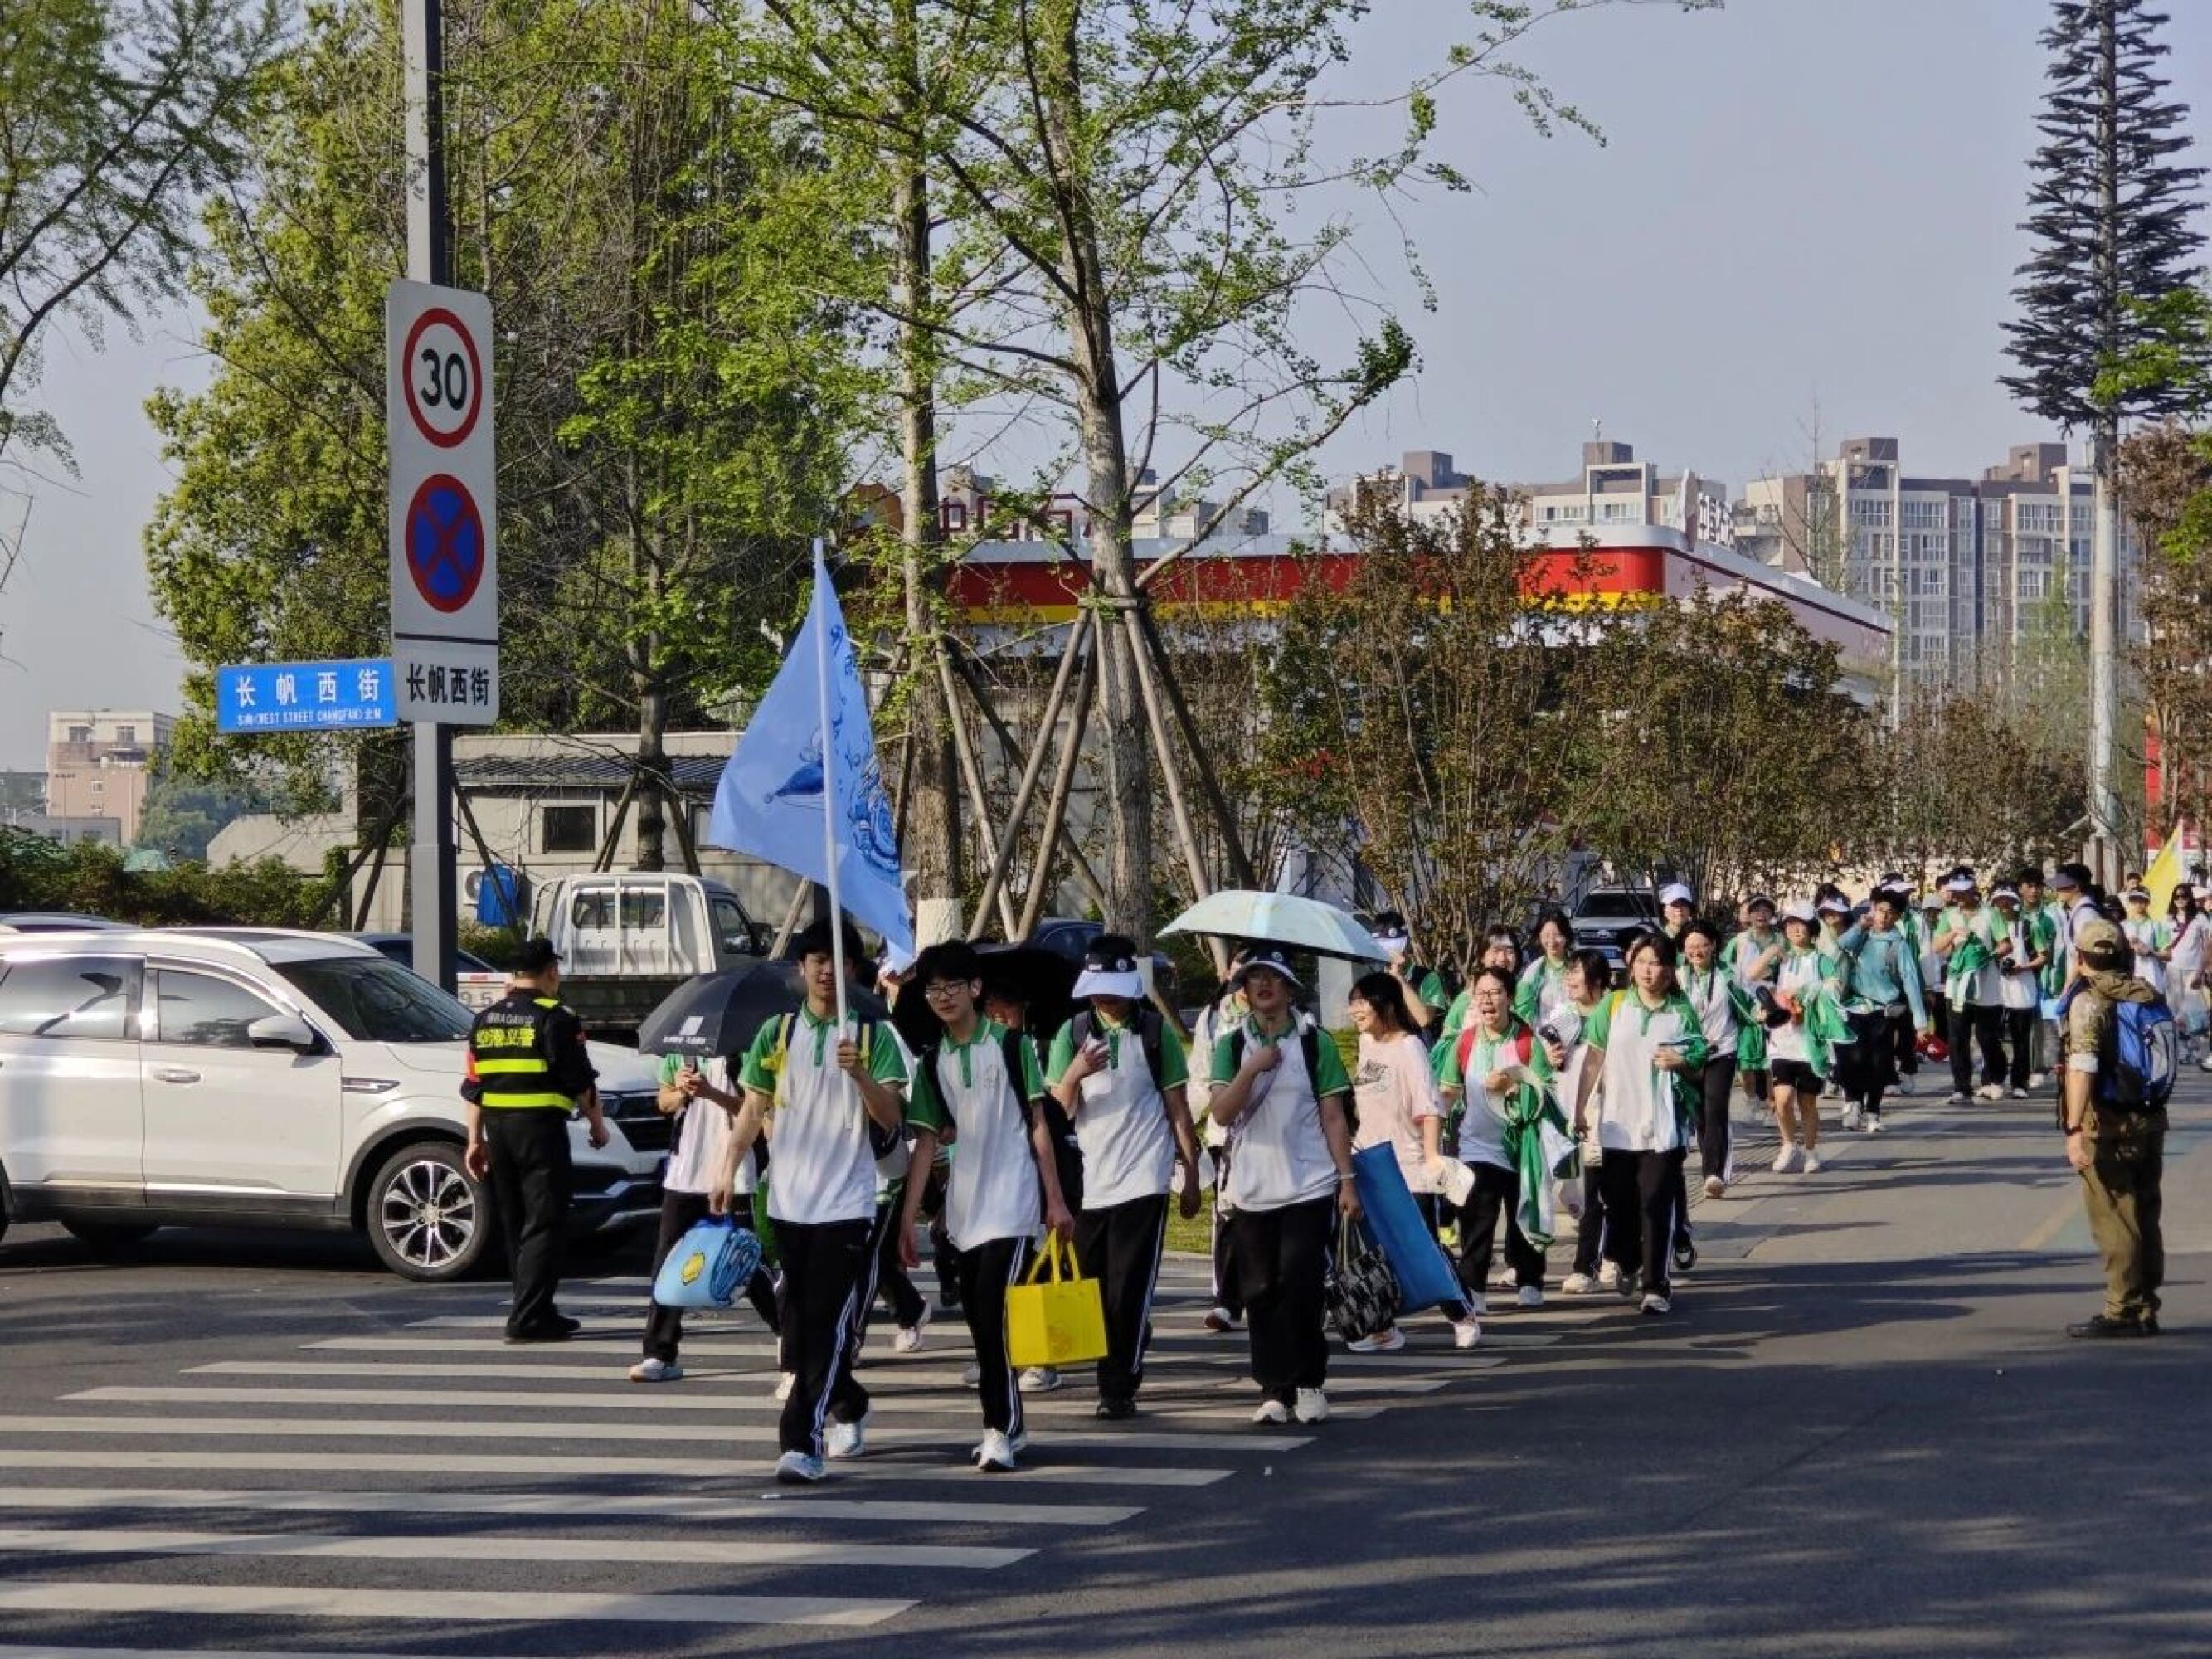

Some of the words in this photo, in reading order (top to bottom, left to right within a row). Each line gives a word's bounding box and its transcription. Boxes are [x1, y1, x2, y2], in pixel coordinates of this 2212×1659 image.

[421, 348, 468, 411] 30
[236, 668, 380, 708] 长帆西街
[406, 663, 489, 705] 长帆西街
[283, 710, 314, 723] STREET
